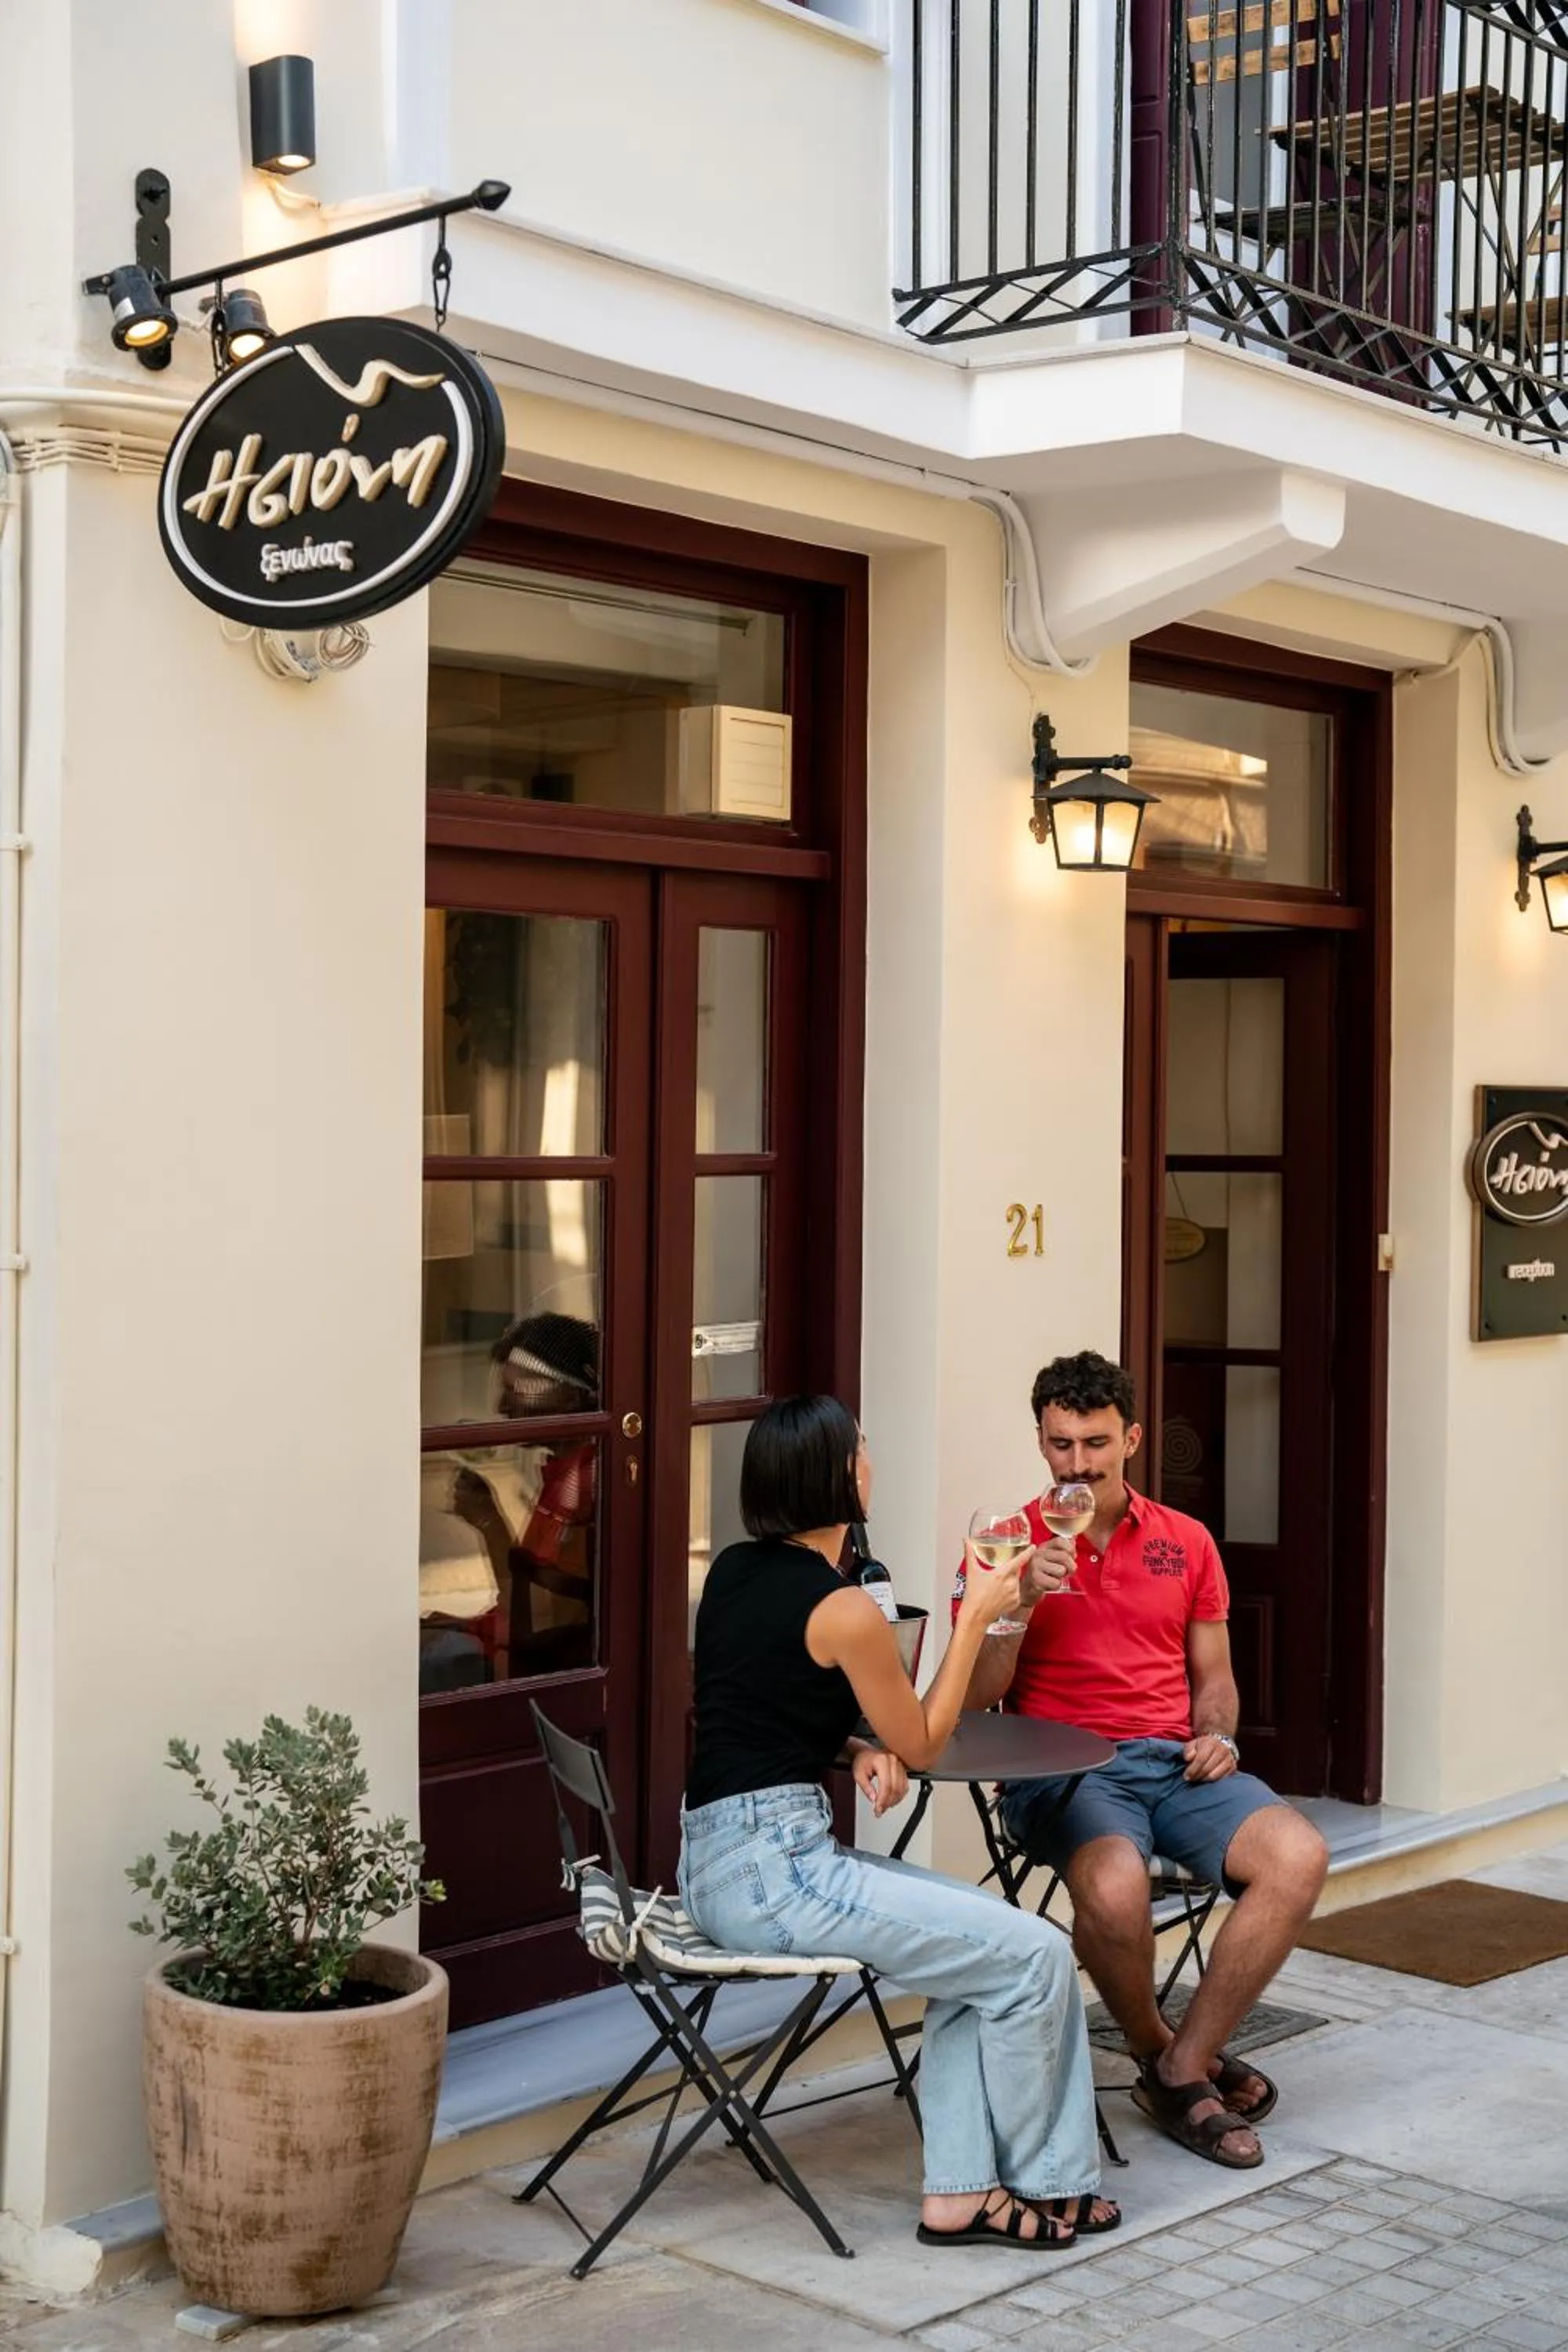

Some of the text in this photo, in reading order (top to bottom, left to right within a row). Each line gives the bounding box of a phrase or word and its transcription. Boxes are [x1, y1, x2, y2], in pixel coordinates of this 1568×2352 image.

[260, 536, 354, 583] ξενώνας
[1006, 1203, 1044, 1256] 21
[1508, 1259, 1555, 1282] reception
